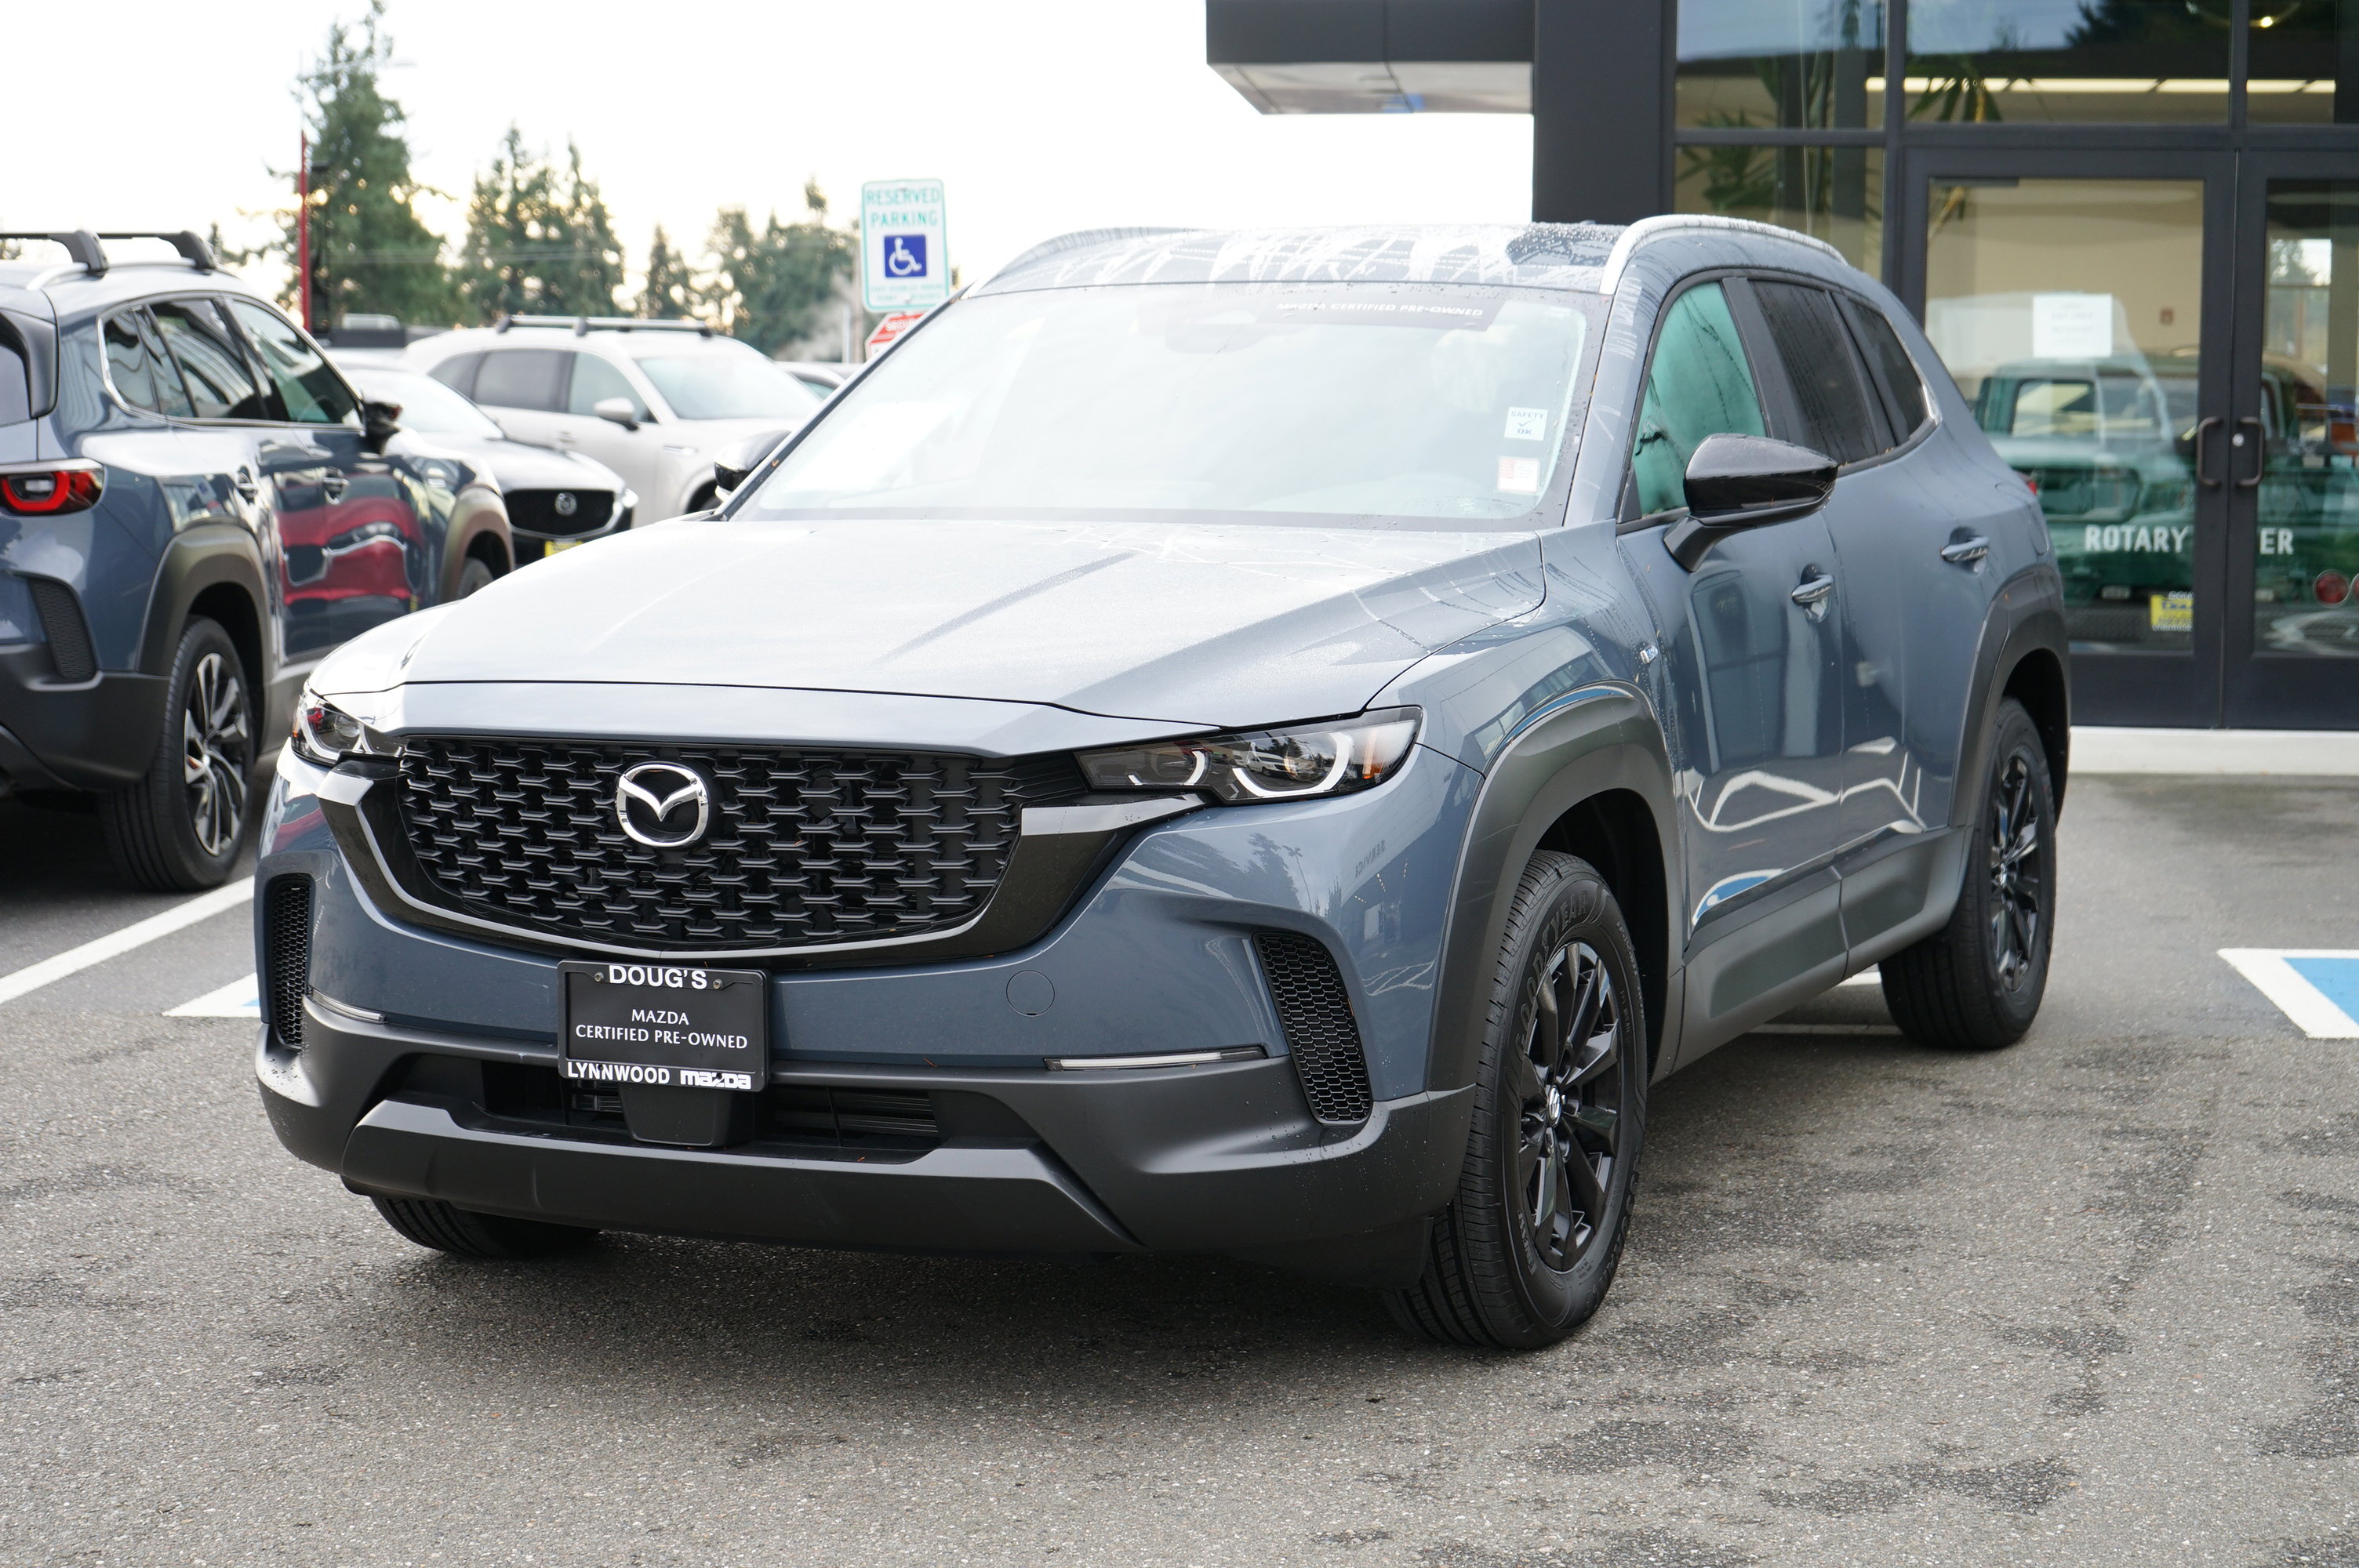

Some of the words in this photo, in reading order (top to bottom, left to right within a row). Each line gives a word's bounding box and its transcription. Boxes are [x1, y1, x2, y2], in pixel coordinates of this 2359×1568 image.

[865, 187, 941, 205] RESERVED
[871, 211, 939, 228] PARKING
[1330, 303, 1396, 312] CERTIFIED
[1400, 305, 1484, 317] PRE-OWNED
[2085, 524, 2190, 553] ROTARY
[2259, 527, 2295, 555] ER
[609, 965, 707, 989] DOUG'S
[631, 1009, 689, 1025] MAZDA
[576, 1025, 649, 1042] CERTIFIED
[654, 1029, 748, 1049] PRE-OWNED
[567, 1062, 670, 1084] LYNNWOOD
